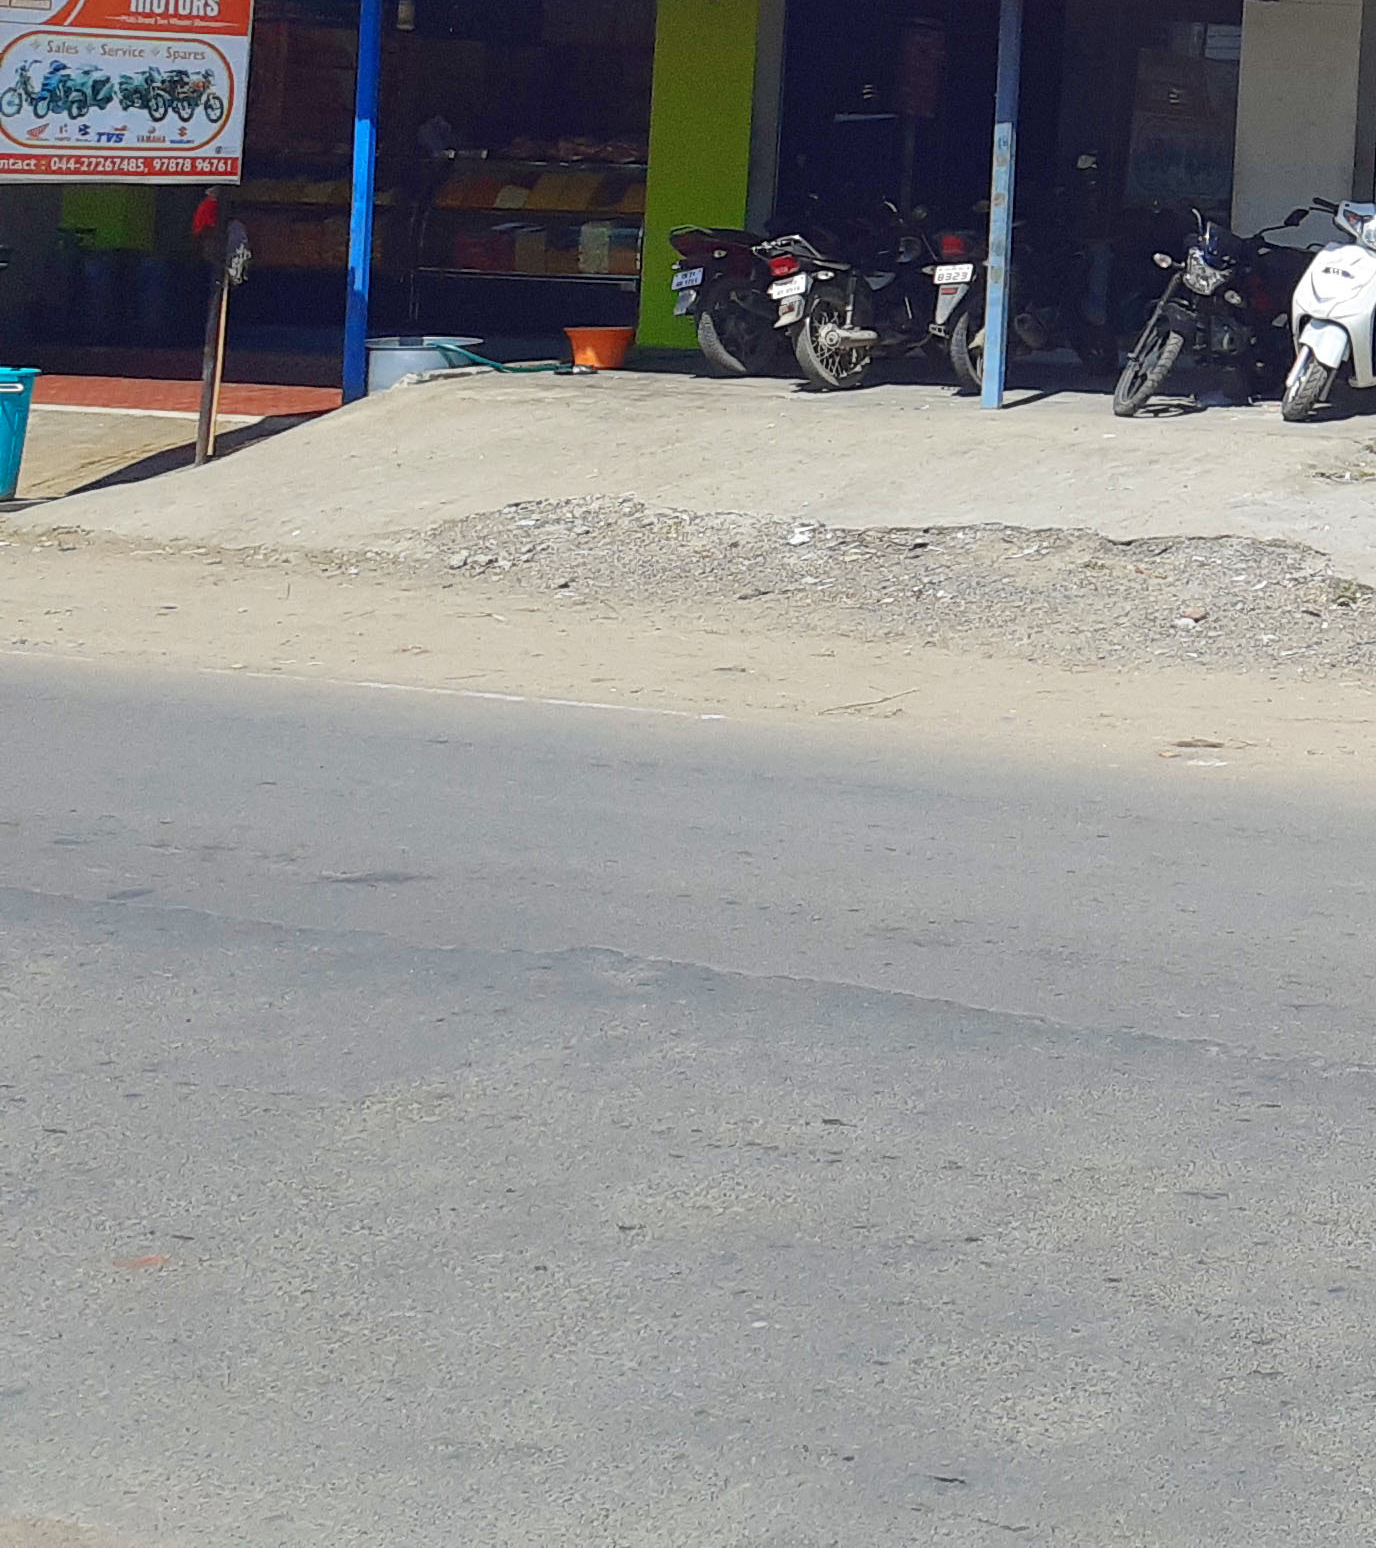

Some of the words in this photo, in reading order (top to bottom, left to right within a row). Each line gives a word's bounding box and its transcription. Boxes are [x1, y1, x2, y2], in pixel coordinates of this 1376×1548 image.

[46, 40, 79, 55] Sales
[100, 43, 145, 59] Service
[165, 46, 206, 63] Spares
[96, 132, 126, 144] TVS
[0, 157, 37, 171] ntact
[50, 158, 149, 173] 044-27267485,
[153, 158, 191, 171] 97878
[194, 159, 232, 172] 96761
